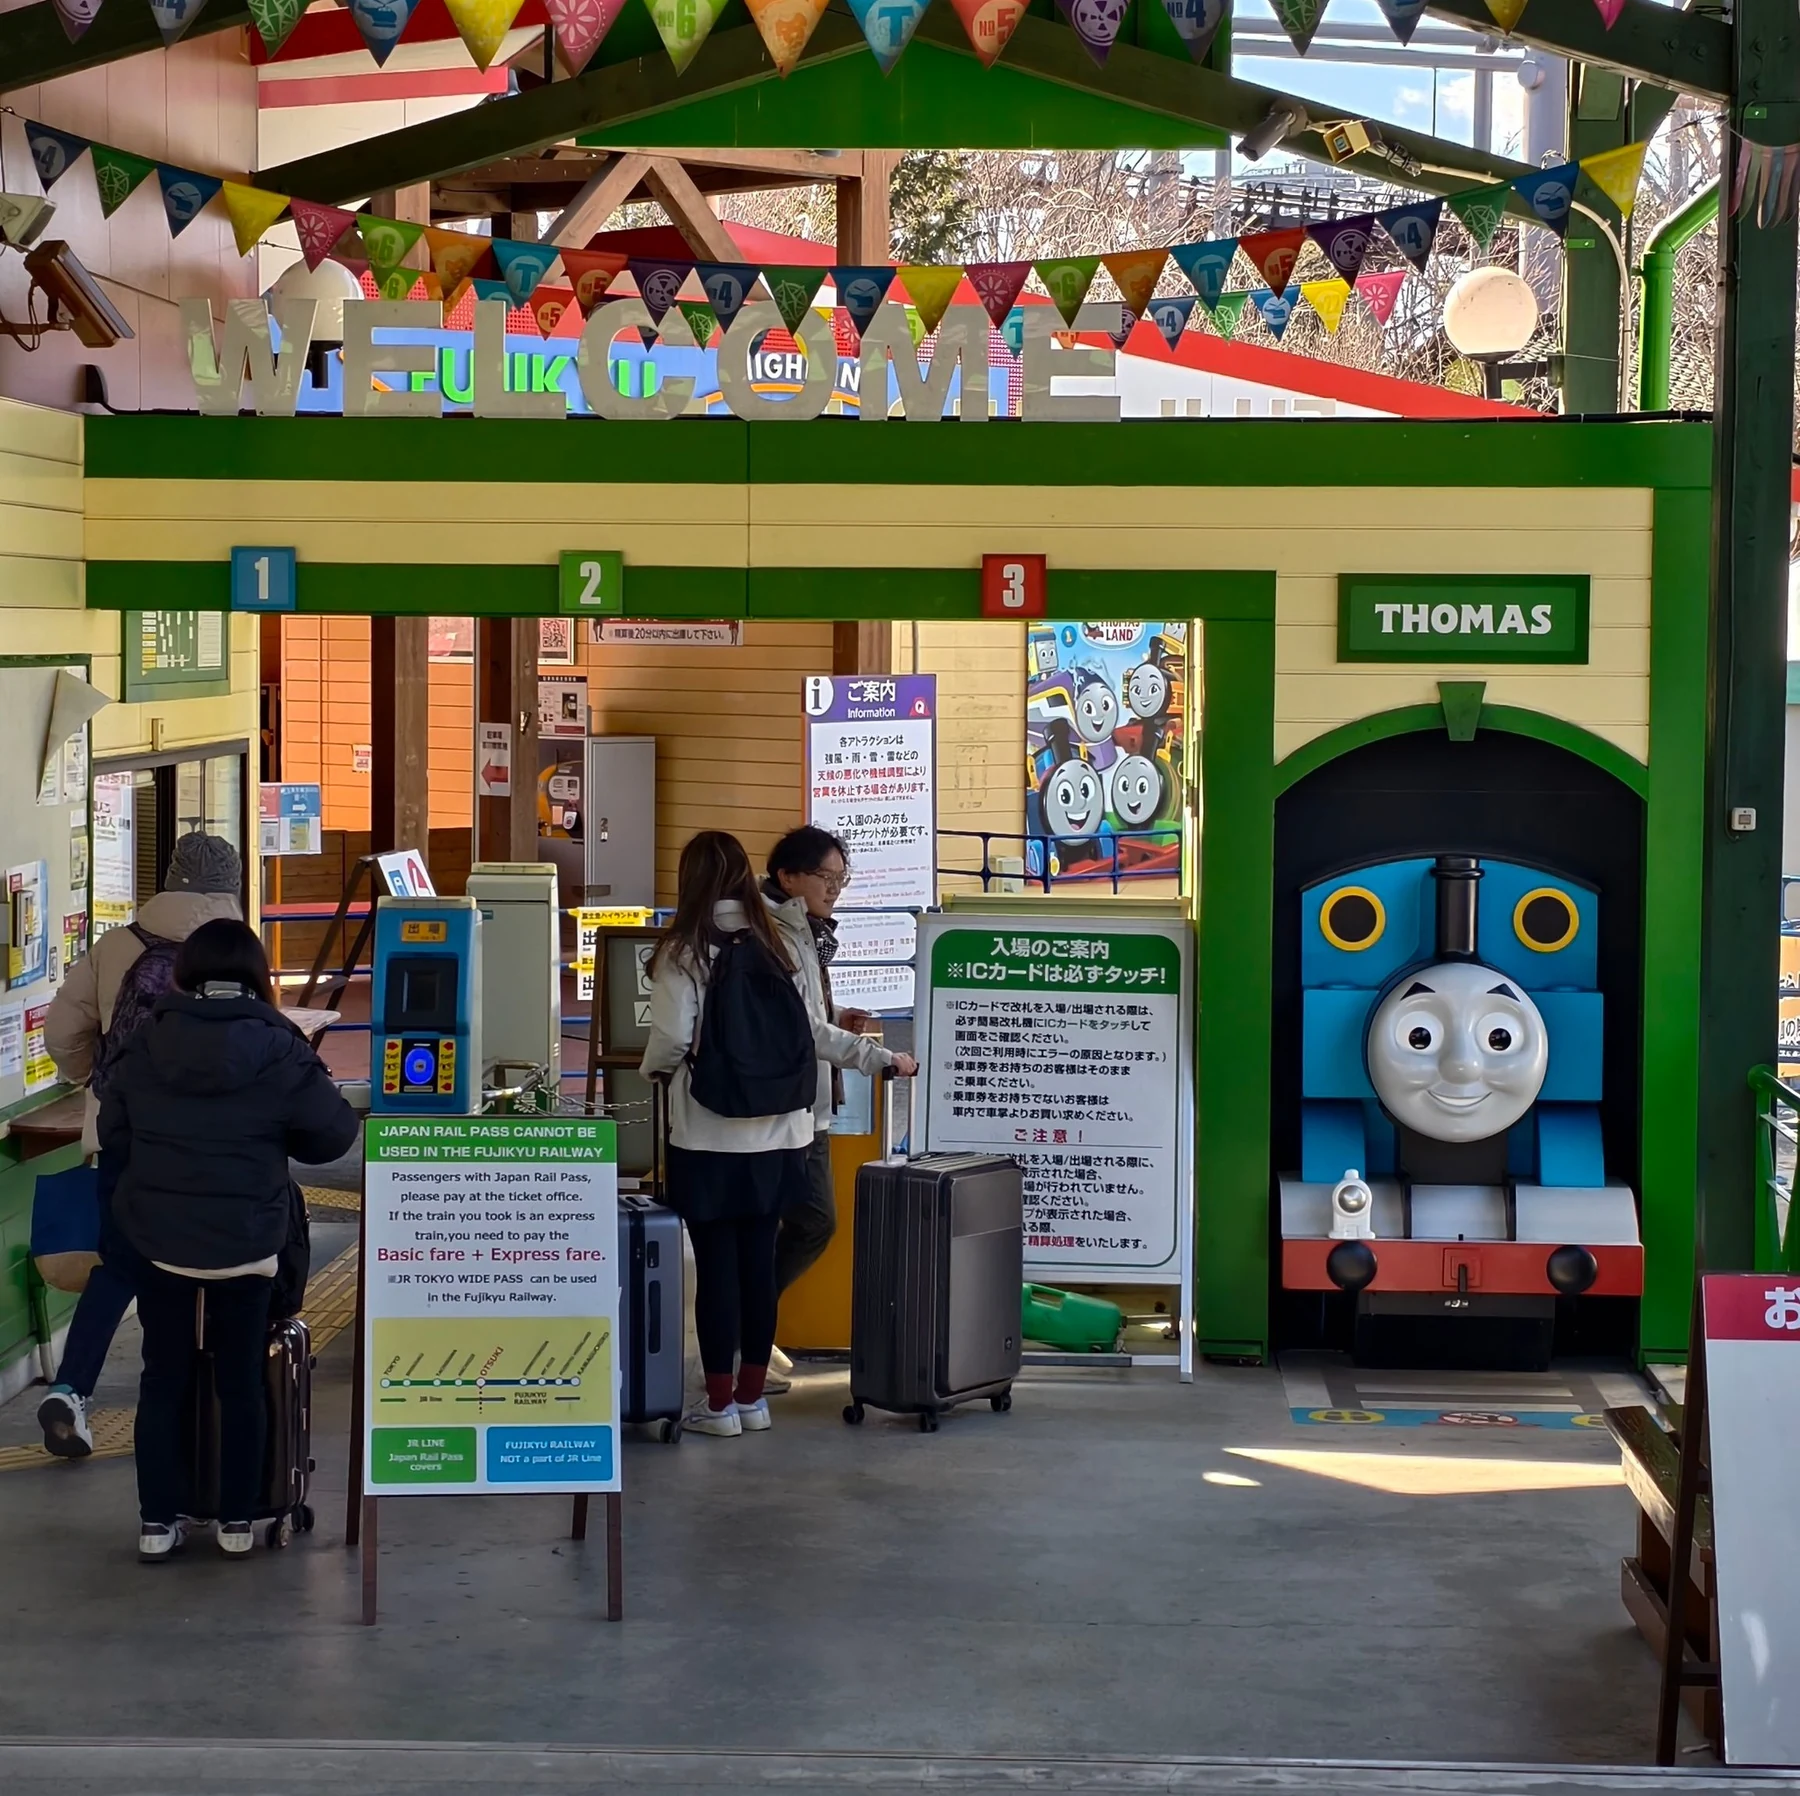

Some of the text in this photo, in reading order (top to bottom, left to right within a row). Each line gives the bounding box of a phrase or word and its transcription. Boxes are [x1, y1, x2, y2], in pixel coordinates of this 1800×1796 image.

[182, 298, 1122, 421] WELCOME
[253, 556, 269, 600] 1
[580, 561, 602, 606] 2
[1002, 564, 1025, 608] 3
[1375, 603, 1552, 635] THOMAS
[1106, 629, 1134, 641] LAND
[847, 680, 896, 702] ご案内
[847, 707, 896, 718] Information
[839, 735, 904, 748] 各アトラクションは
[837, 812, 909, 826] ご入園のみの方も
[990, 937, 1109, 960] 入場のご案内
[955, 1031, 1069, 1044] 画面をご確認ください。
[954, 1076, 1036, 1089] ご乗車ください。
[379, 1126, 596, 1138] JAPAN RAIL PASS CANNOT BE
[379, 1146, 603, 1158] USED IN THE FUJIKYU RAILWAY
[392, 1172, 592, 1184] Passengers with Japan Rail Pass,
[400, 1191, 583, 1203] please pay at the ticket office.
[389, 1211, 595, 1223] If the train you took is an express
[474, 1231, 504, 1241] need
[507, 1231, 520, 1241] to
[523, 1233, 545, 1242] pay
[549, 1231, 569, 1241] the
[377, 1248, 424, 1261] Basic
[429, 1248, 465, 1261] fare
[491, 1248, 560, 1264] Express
[565, 1248, 606, 1261] fare.
[414, 1274, 454, 1284] TOKYO
[458, 1274, 490, 1284] WIDE
[494, 1274, 523, 1284] PASS
[530, 1276, 550, 1284] can
[553, 1274, 567, 1284] be
[570, 1274, 597, 1284] used
[428, 1292, 557, 1303] in the Fujikyu Railway.
[1764, 1286, 1800, 1330] お
[383, 1355, 400, 1376] TOKYO
[480, 1346, 504, 1376] OTSUKI
[407, 1439, 445, 1448] JR LINE
[505, 1440, 596, 1450] FUJIKYU RAILWAY
[388, 1453, 464, 1462] Japan Rail Pass
[500, 1455, 521, 1463] NOT
[532, 1455, 552, 1464] part
[567, 1454, 579, 1462] JR
[410, 1463, 442, 1471] covers
